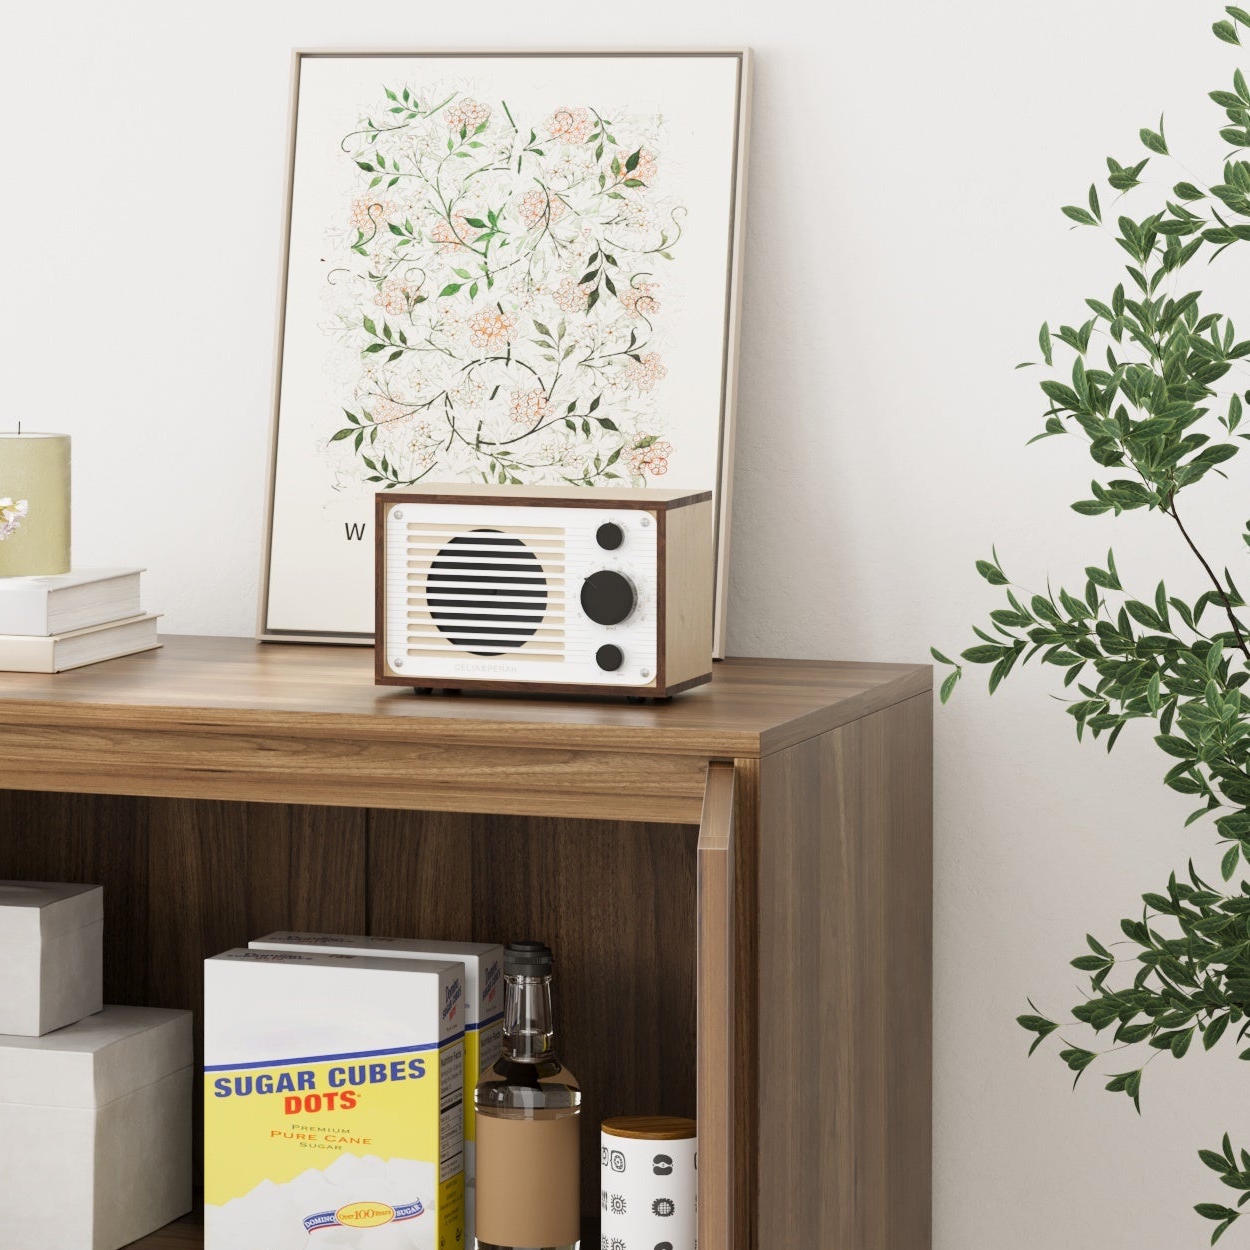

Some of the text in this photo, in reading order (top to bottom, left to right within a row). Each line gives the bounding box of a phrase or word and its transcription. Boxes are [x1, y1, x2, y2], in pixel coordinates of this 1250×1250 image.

[345, 522, 366, 541] W
[214, 1070, 315, 1098] SUGAR
[328, 1058, 426, 1088] CUBES
[354, 1208, 375, 1220] 100
[396, 1204, 421, 1217] SUGAR
